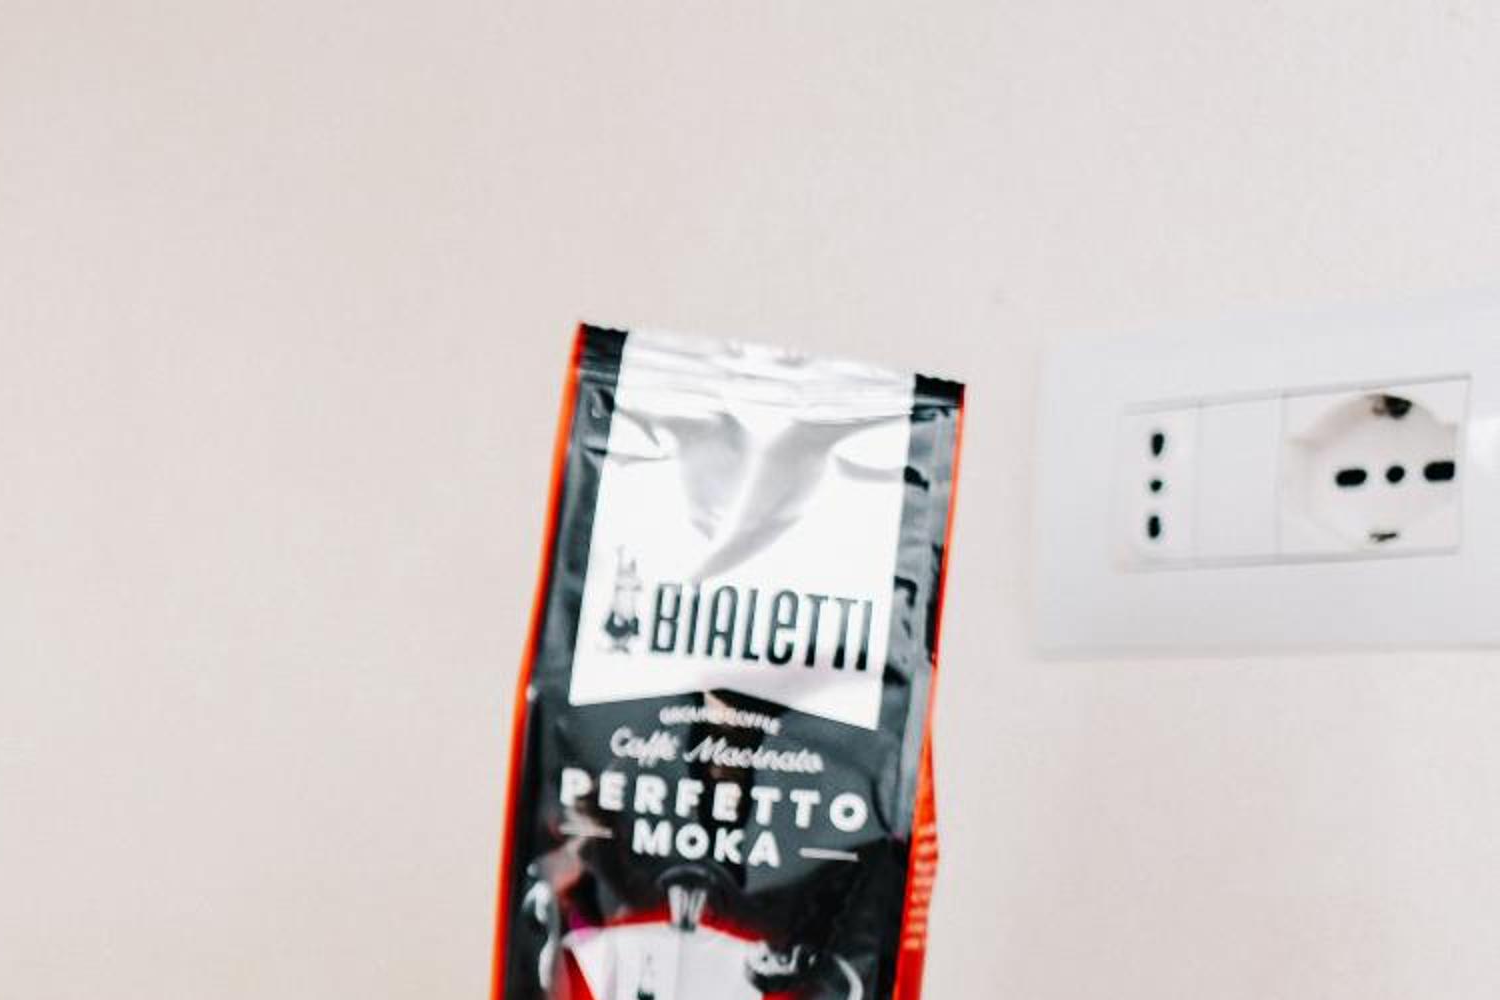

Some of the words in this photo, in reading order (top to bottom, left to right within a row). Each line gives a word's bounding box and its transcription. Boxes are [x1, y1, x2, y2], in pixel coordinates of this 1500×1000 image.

[650, 582, 874, 672] BIALETTI
[683, 735, 824, 774] Macinato
[559, 766, 869, 833] PERFETTO
[631, 818, 781, 868] MOKA
